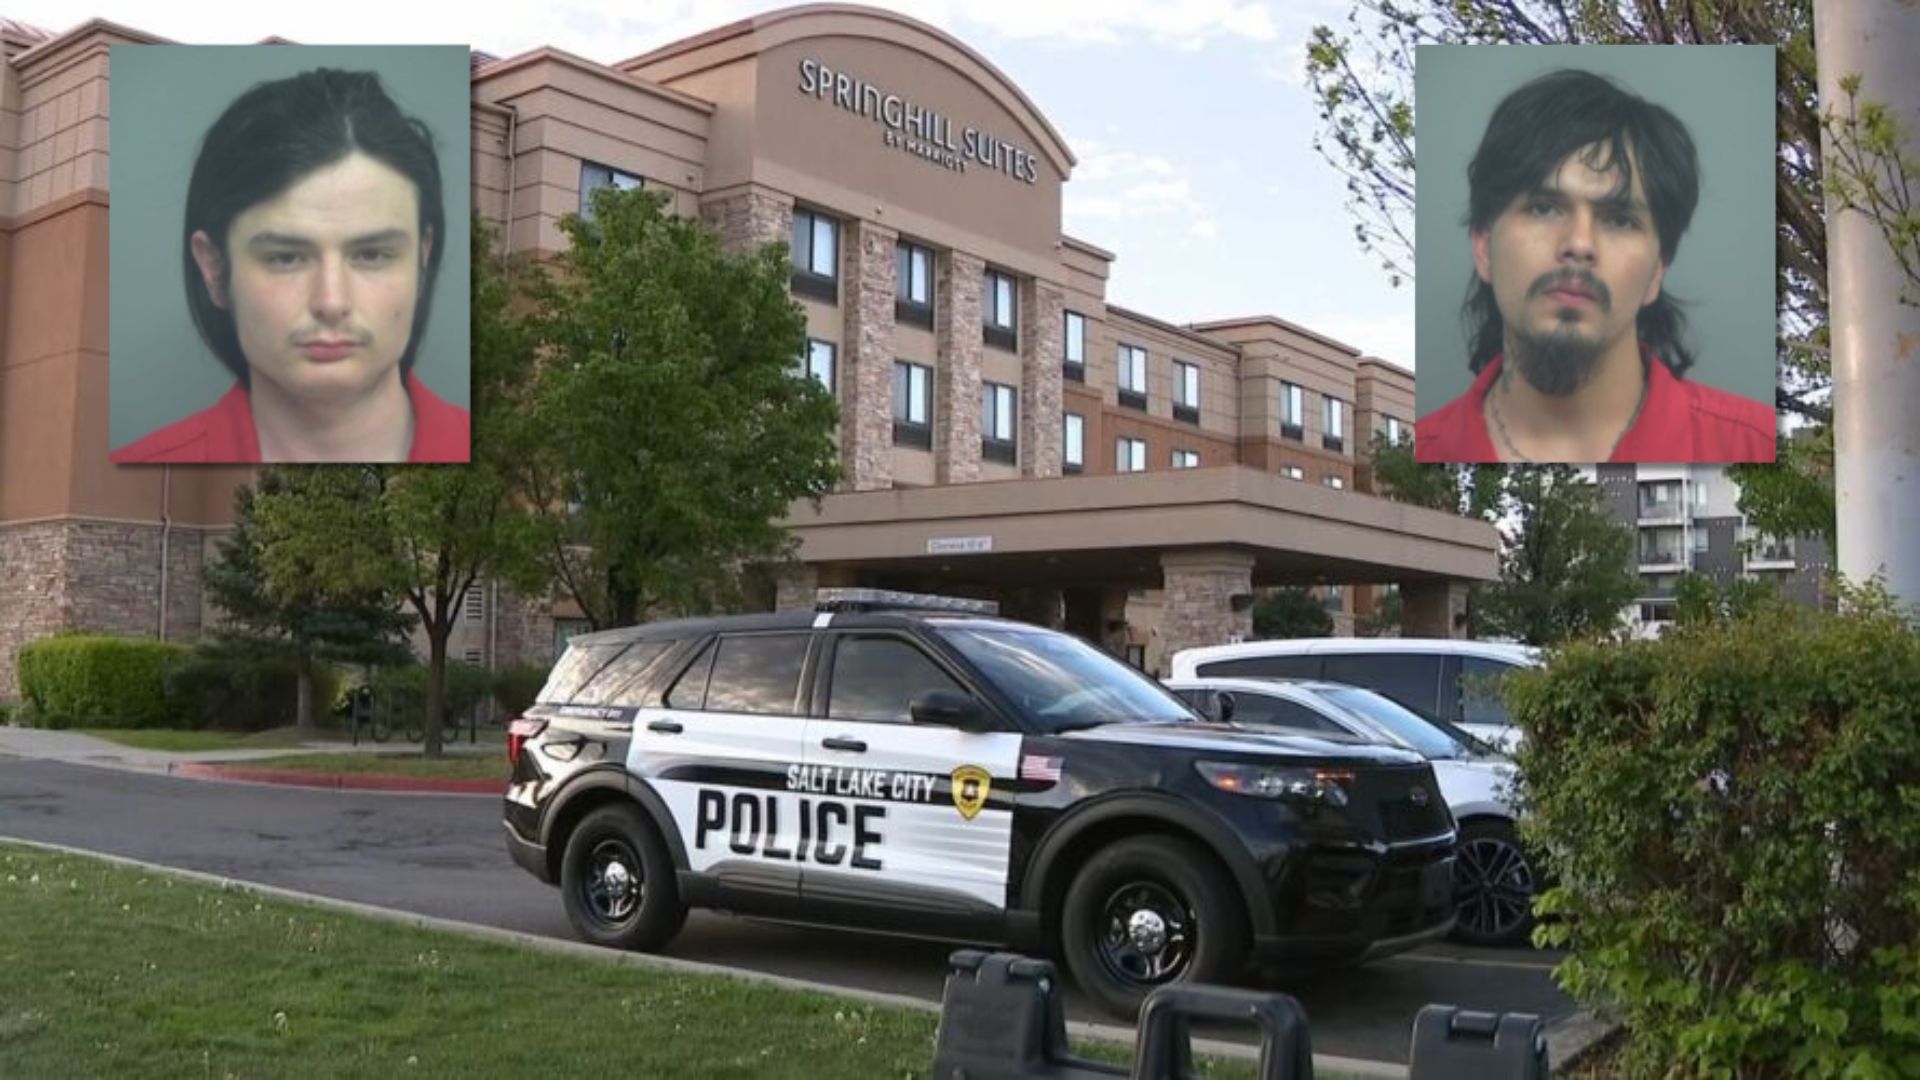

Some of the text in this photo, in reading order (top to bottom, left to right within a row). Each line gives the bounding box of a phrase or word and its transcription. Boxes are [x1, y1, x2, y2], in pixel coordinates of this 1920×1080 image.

[799, 59, 1037, 184] SPRINGHILL SUITES
[884, 130, 968, 173] BY MARRIOTT
[786, 764, 936, 802] SALT LAKE CITY
[695, 788, 887, 871] POLICE
